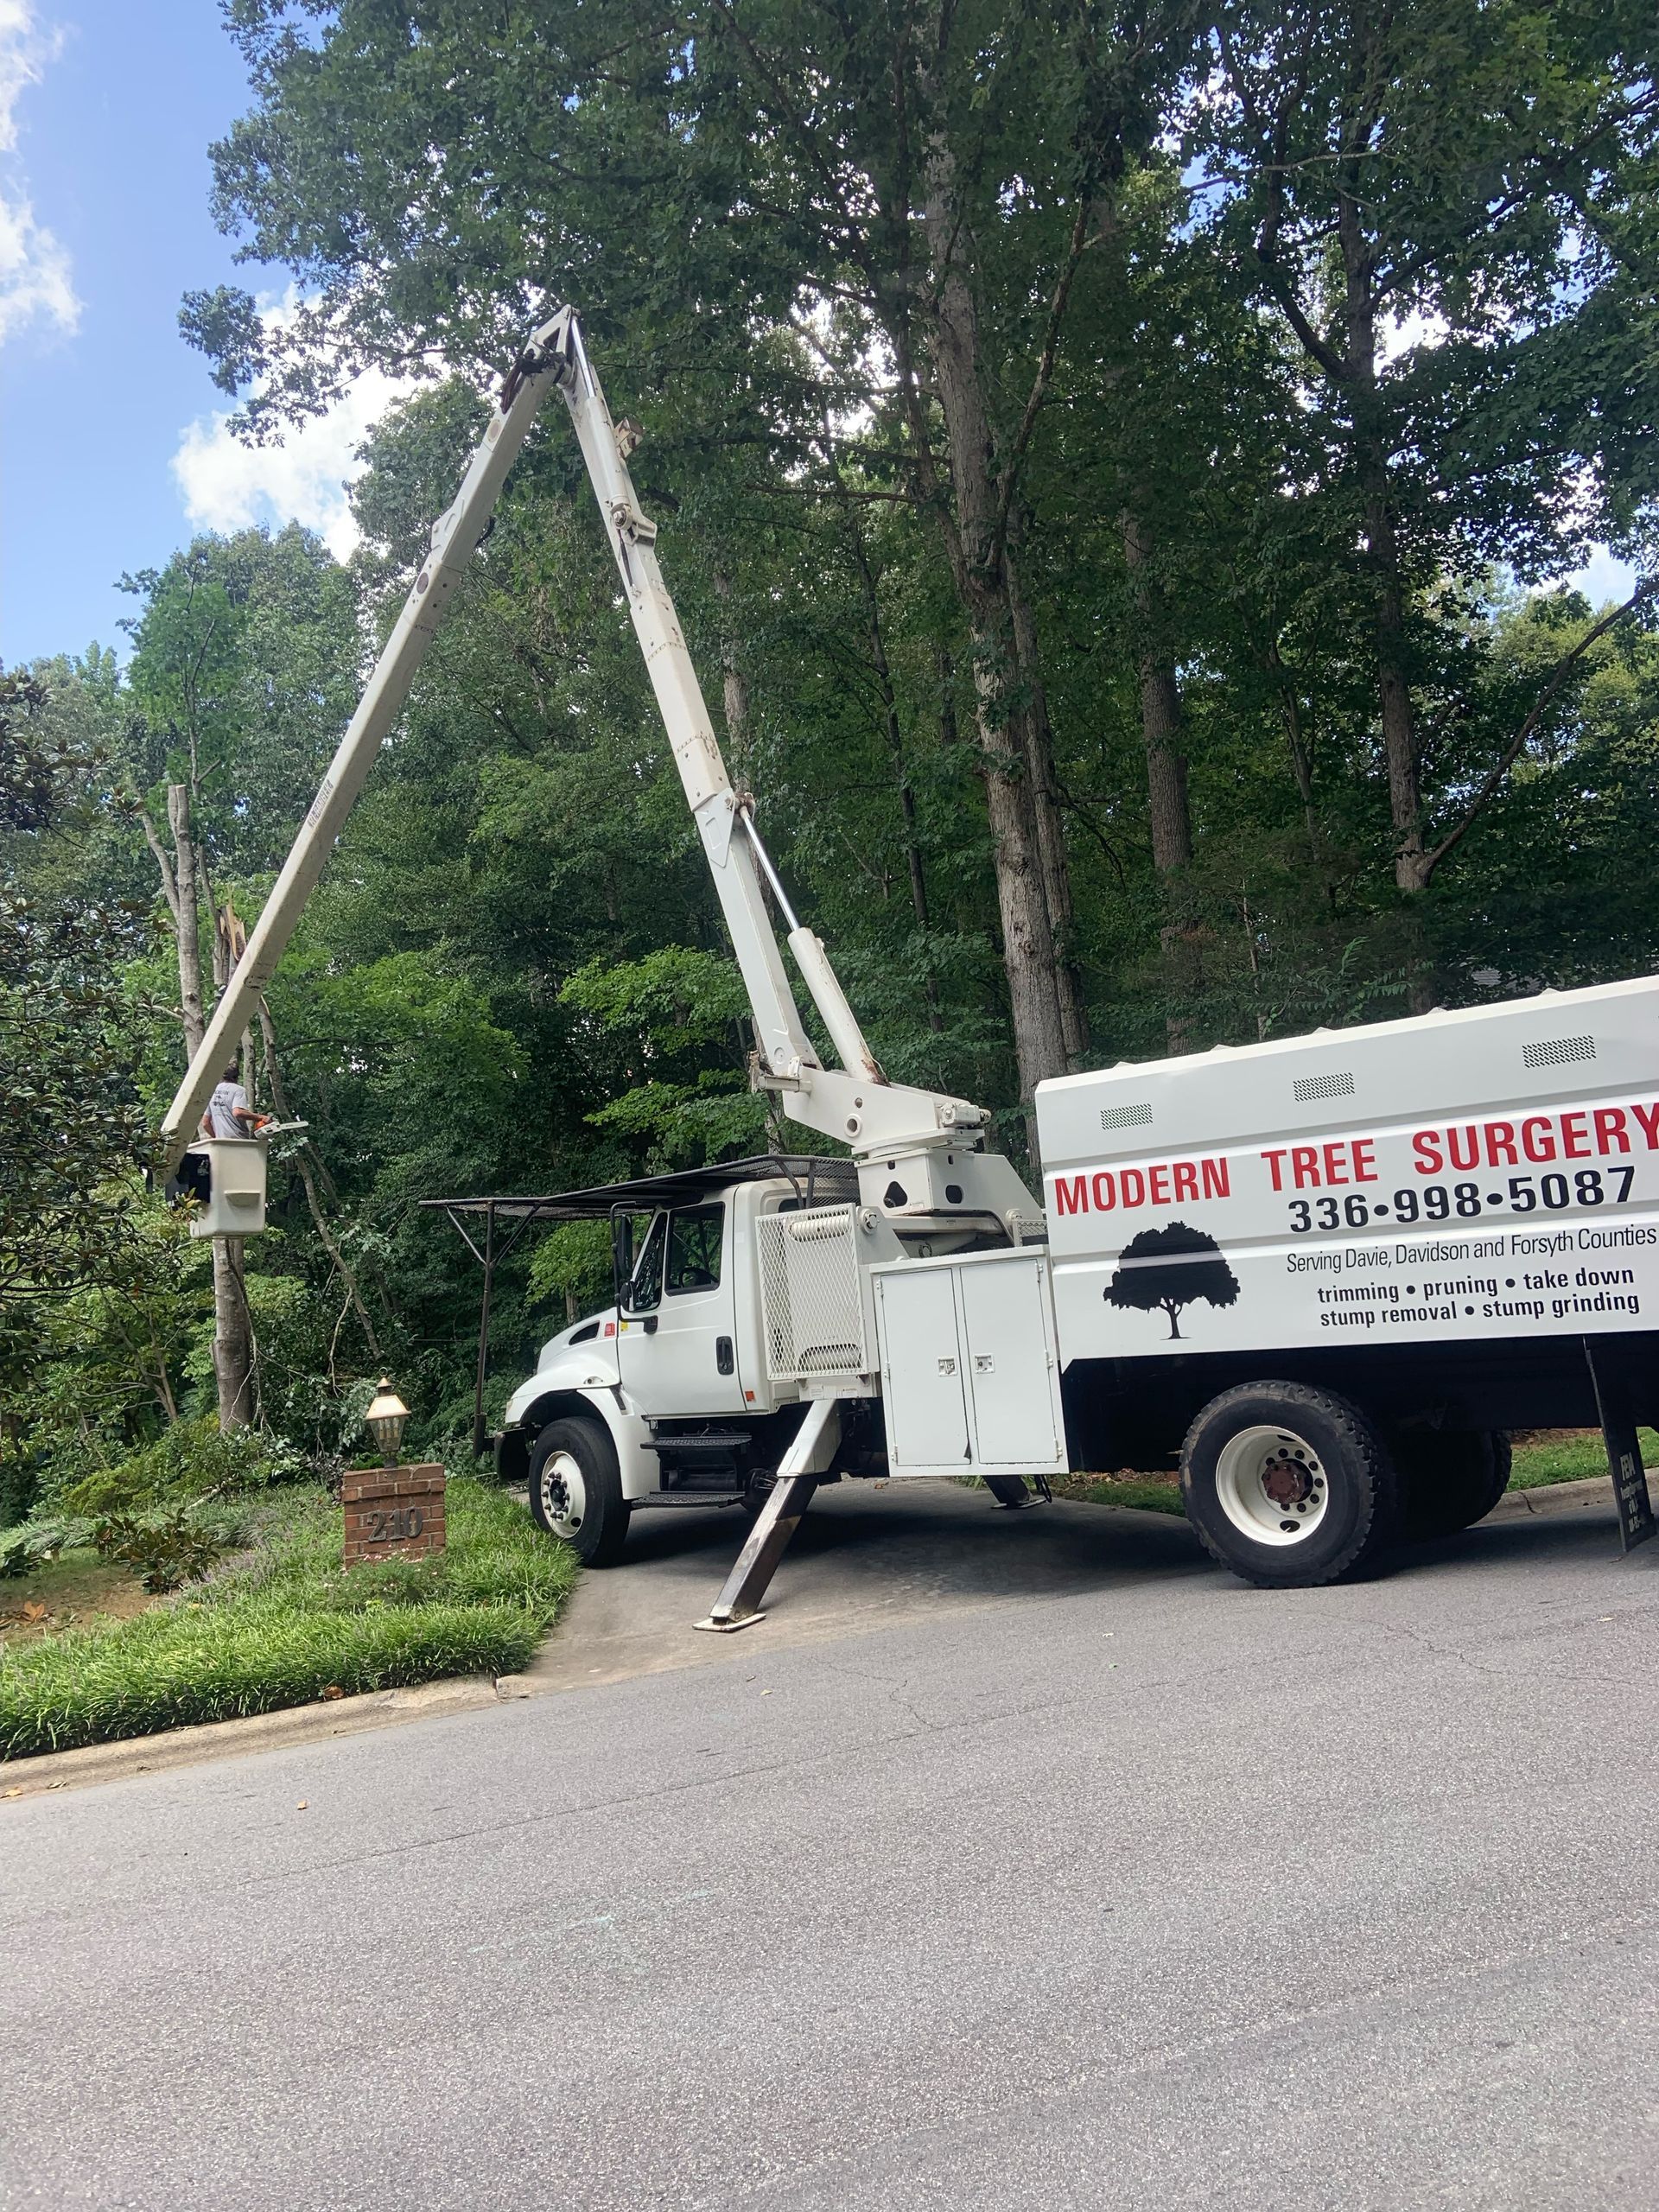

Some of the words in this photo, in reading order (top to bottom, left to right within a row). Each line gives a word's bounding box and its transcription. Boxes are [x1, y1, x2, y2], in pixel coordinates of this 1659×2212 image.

[1054, 1157, 1231, 1216] MODERN
[1260, 1139, 1378, 1192] TREE
[1412, 1102, 1659, 1175] SURGERY
[1287, 1250, 1342, 1274] Serving
[1345, 1246, 1392, 1268] Davie,
[1395, 1241, 1470, 1265] Davidson
[1473, 1236, 1504, 1259] and
[1511, 1230, 1573, 1257] Forsyth
[1578, 1224, 1657, 1250] Counties
[1317, 1282, 1400, 1303] trimming
[1423, 1275, 1498, 1300] pruning
[1523, 1269, 1569, 1290] take
[1575, 1267, 1635, 1287] down
[1320, 1310, 1376, 1328] stump
[1382, 1300, 1458, 1324] removal
[1482, 1300, 1545, 1319] stump
[1552, 1292, 1640, 1319] grinding
[367, 1506, 423, 1543] 210
